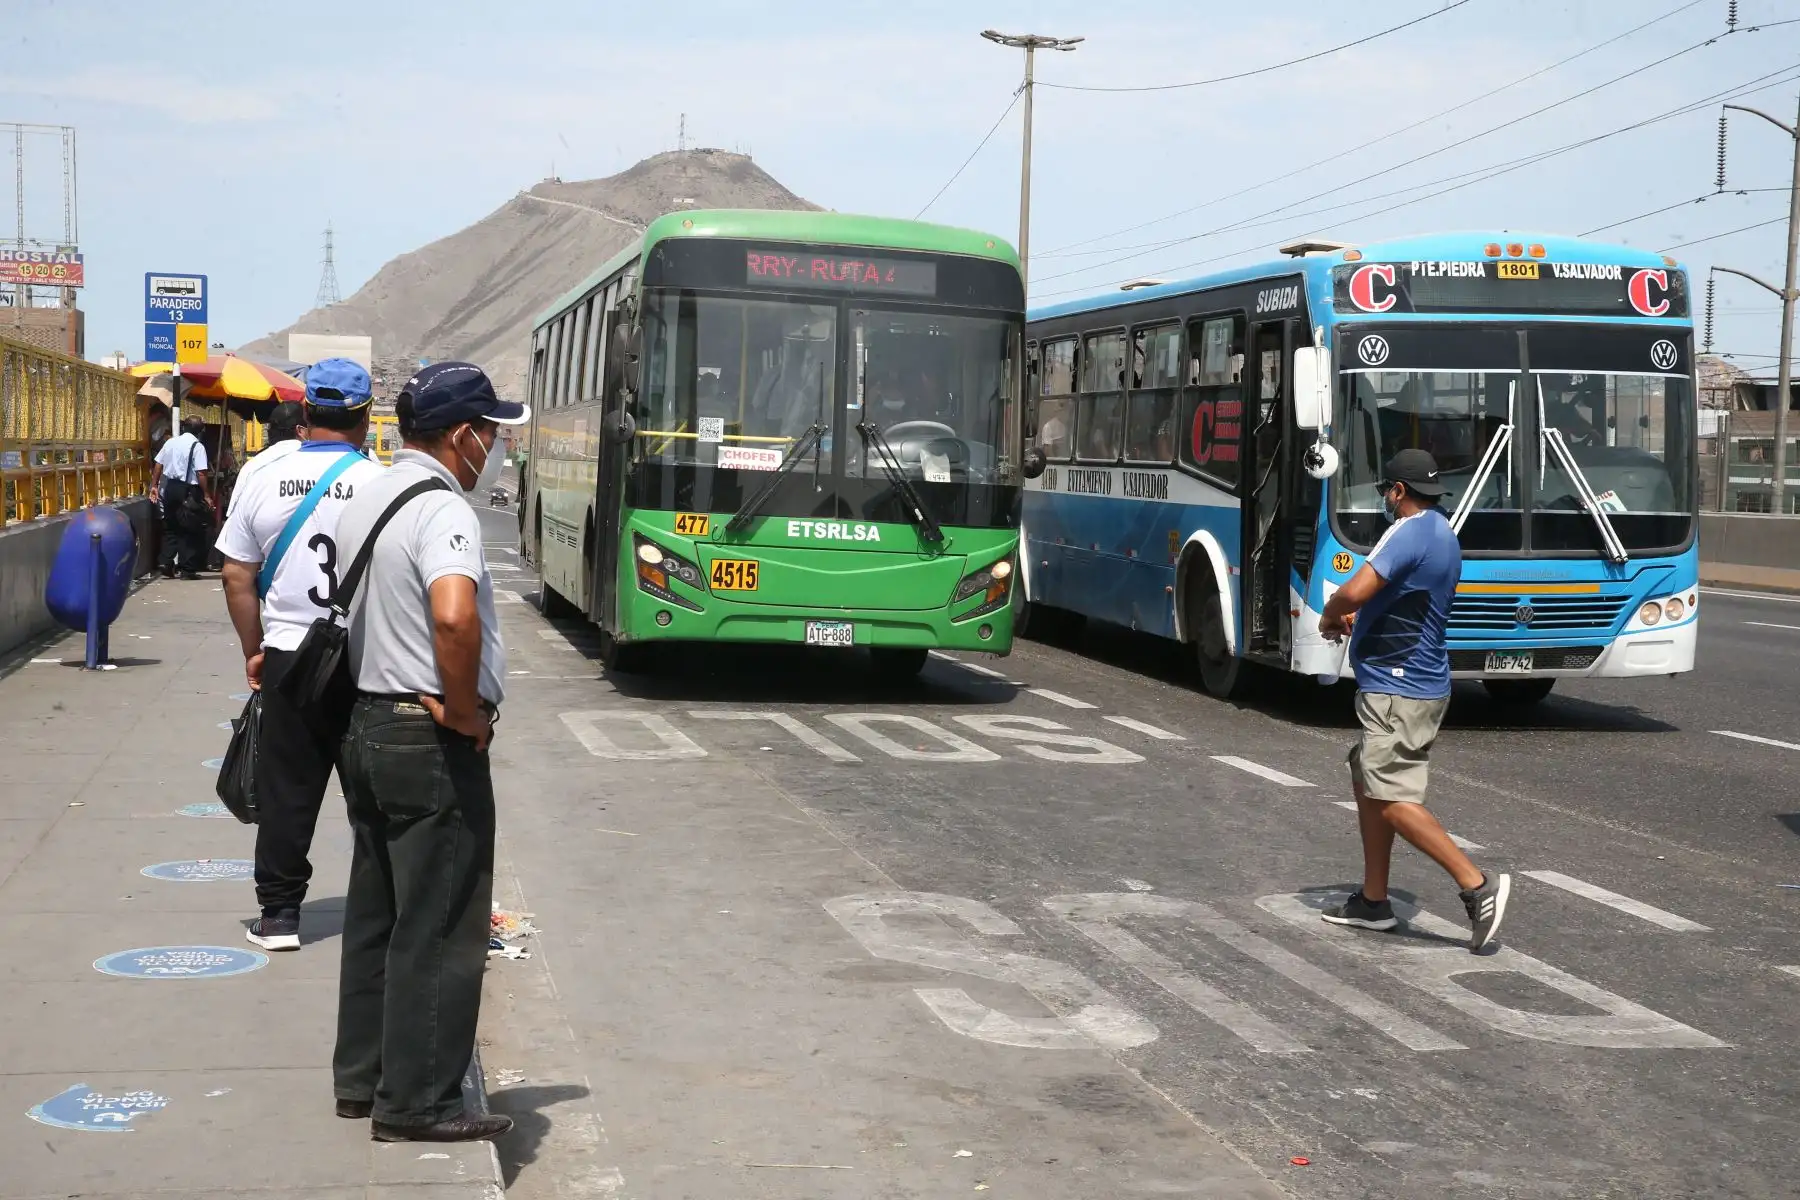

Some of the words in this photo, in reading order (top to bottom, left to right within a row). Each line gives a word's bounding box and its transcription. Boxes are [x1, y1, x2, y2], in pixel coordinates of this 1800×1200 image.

[1, 250, 81, 264] HOSTAL
[811, 258, 879, 283] RUTA
[1411, 260, 1486, 278] PTE.PIEDRA
[1501, 263, 1536, 278] 1801
[1552, 263, 1622, 281] V.SALVADOR
[1348, 264, 1397, 313] C
[1627, 268, 1671, 316] C
[150, 297, 202, 310] PARADERO
[1256, 286, 1299, 313] SUBIDA
[168, 309, 184, 321] 13
[182, 339, 202, 349] 107
[723, 449, 776, 463] CHOFER
[1122, 471, 1169, 500] V.SALVADOR
[677, 515, 707, 533] 477
[787, 521, 881, 542] ETSRLSA
[308, 533, 339, 608] 3
[1334, 554, 1352, 571] 32
[713, 560, 756, 589] 4515
[808, 627, 851, 642] ATG-888
[1486, 656, 1531, 670] ADG-742
